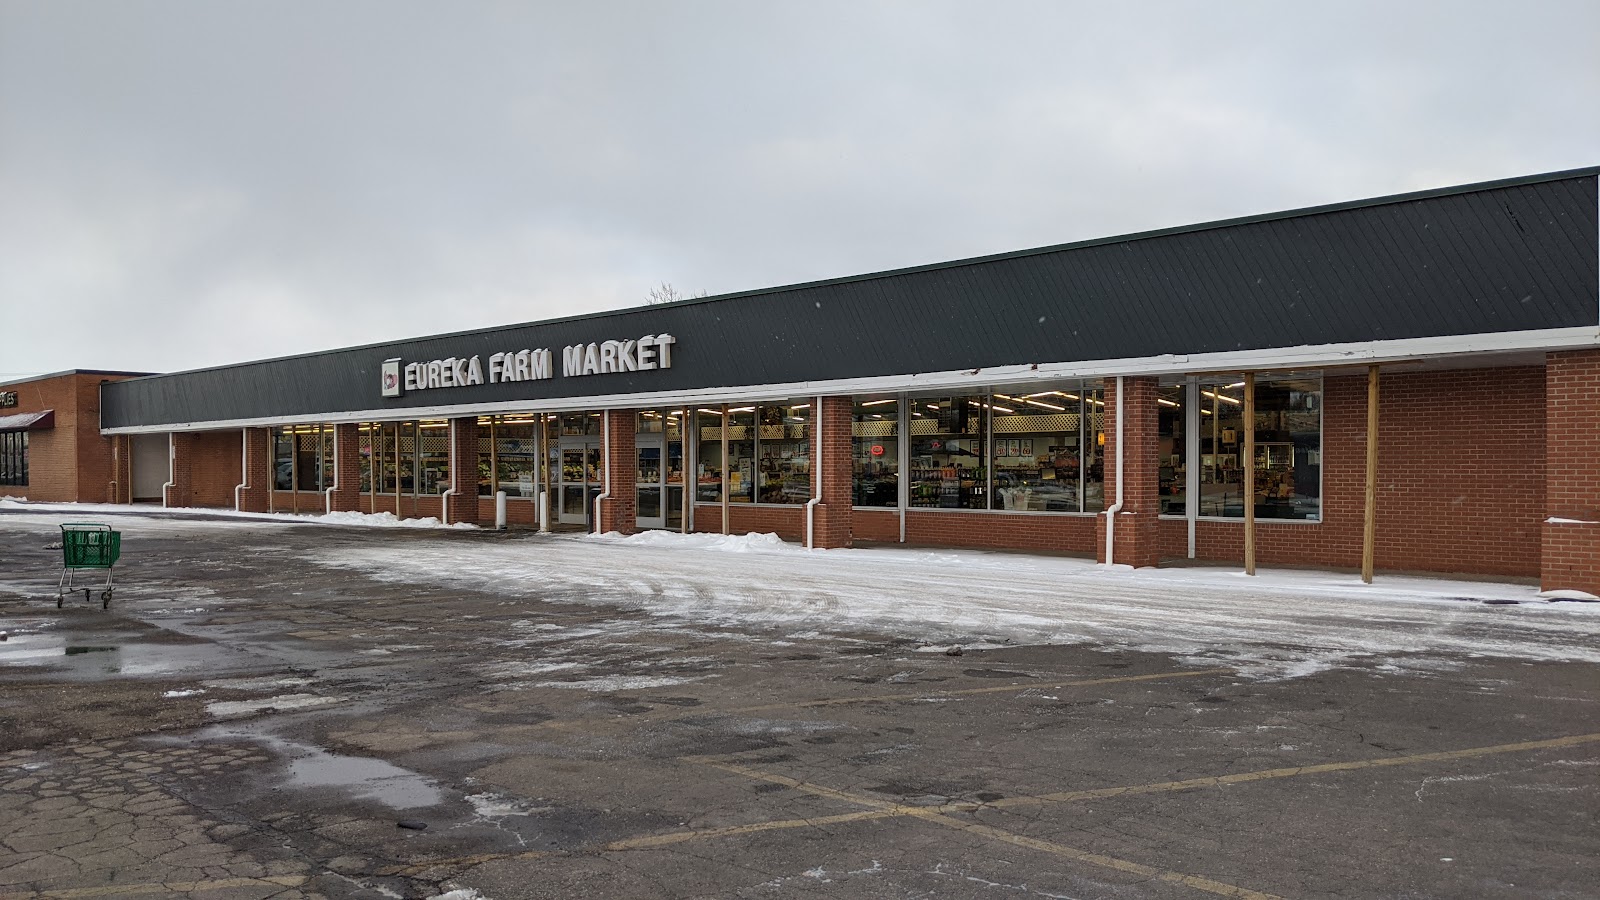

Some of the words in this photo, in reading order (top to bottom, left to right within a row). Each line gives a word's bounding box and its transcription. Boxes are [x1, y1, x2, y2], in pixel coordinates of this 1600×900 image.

[405, 356, 483, 390] EUREKA
[489, 349, 552, 383] FARM
[563, 334, 675, 377] MARKET
